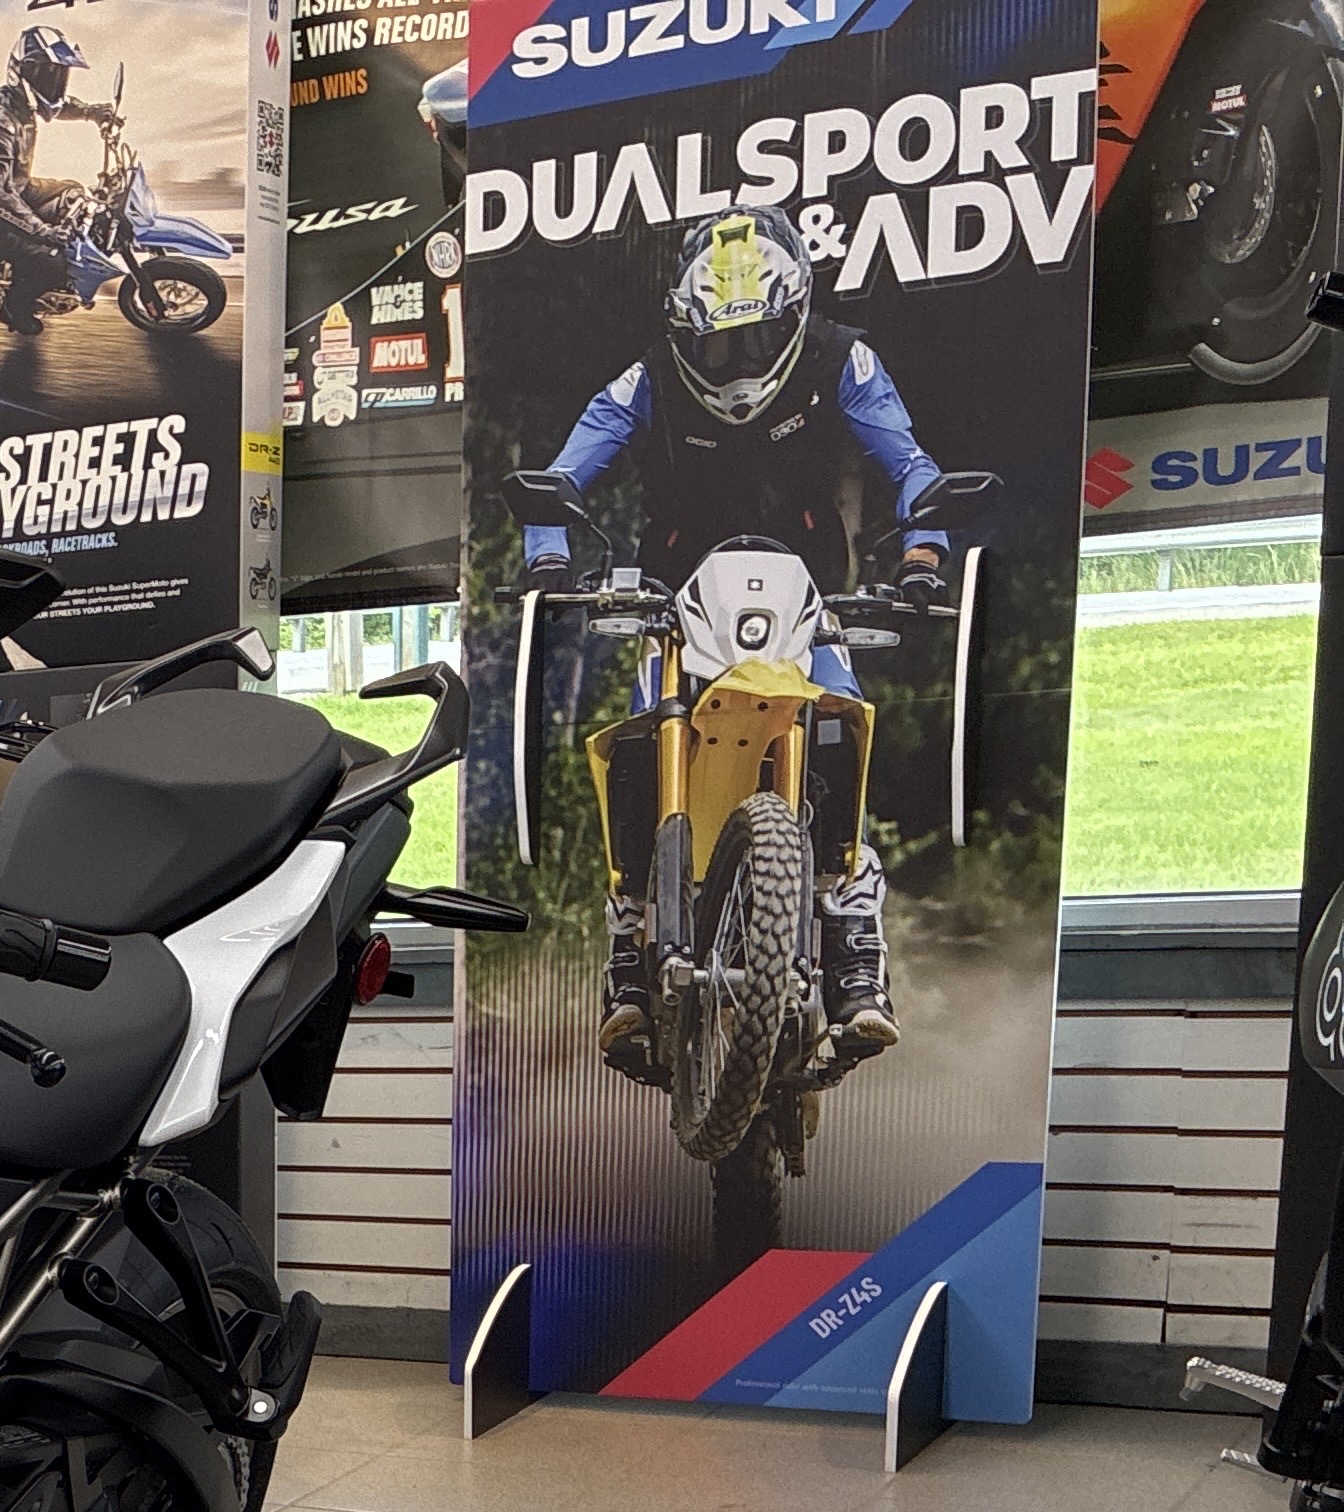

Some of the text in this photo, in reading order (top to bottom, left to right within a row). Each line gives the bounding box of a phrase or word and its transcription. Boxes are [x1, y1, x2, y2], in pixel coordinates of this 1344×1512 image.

[307, 18, 369, 58] WINS
[373, 10, 469, 46] RECORD
[322, 68, 368, 100] WINS
[465, 68, 1097, 256] DUALSPORT
[287, 197, 419, 234] usa
[371, 281, 424, 306] VANCE
[371, 303, 425, 325] HINES
[373, 338, 426, 368] MOTUL
[51, 532, 119, 552] RACETRACKS.
[808, 1276, 883, 1339] DR-Z4S
